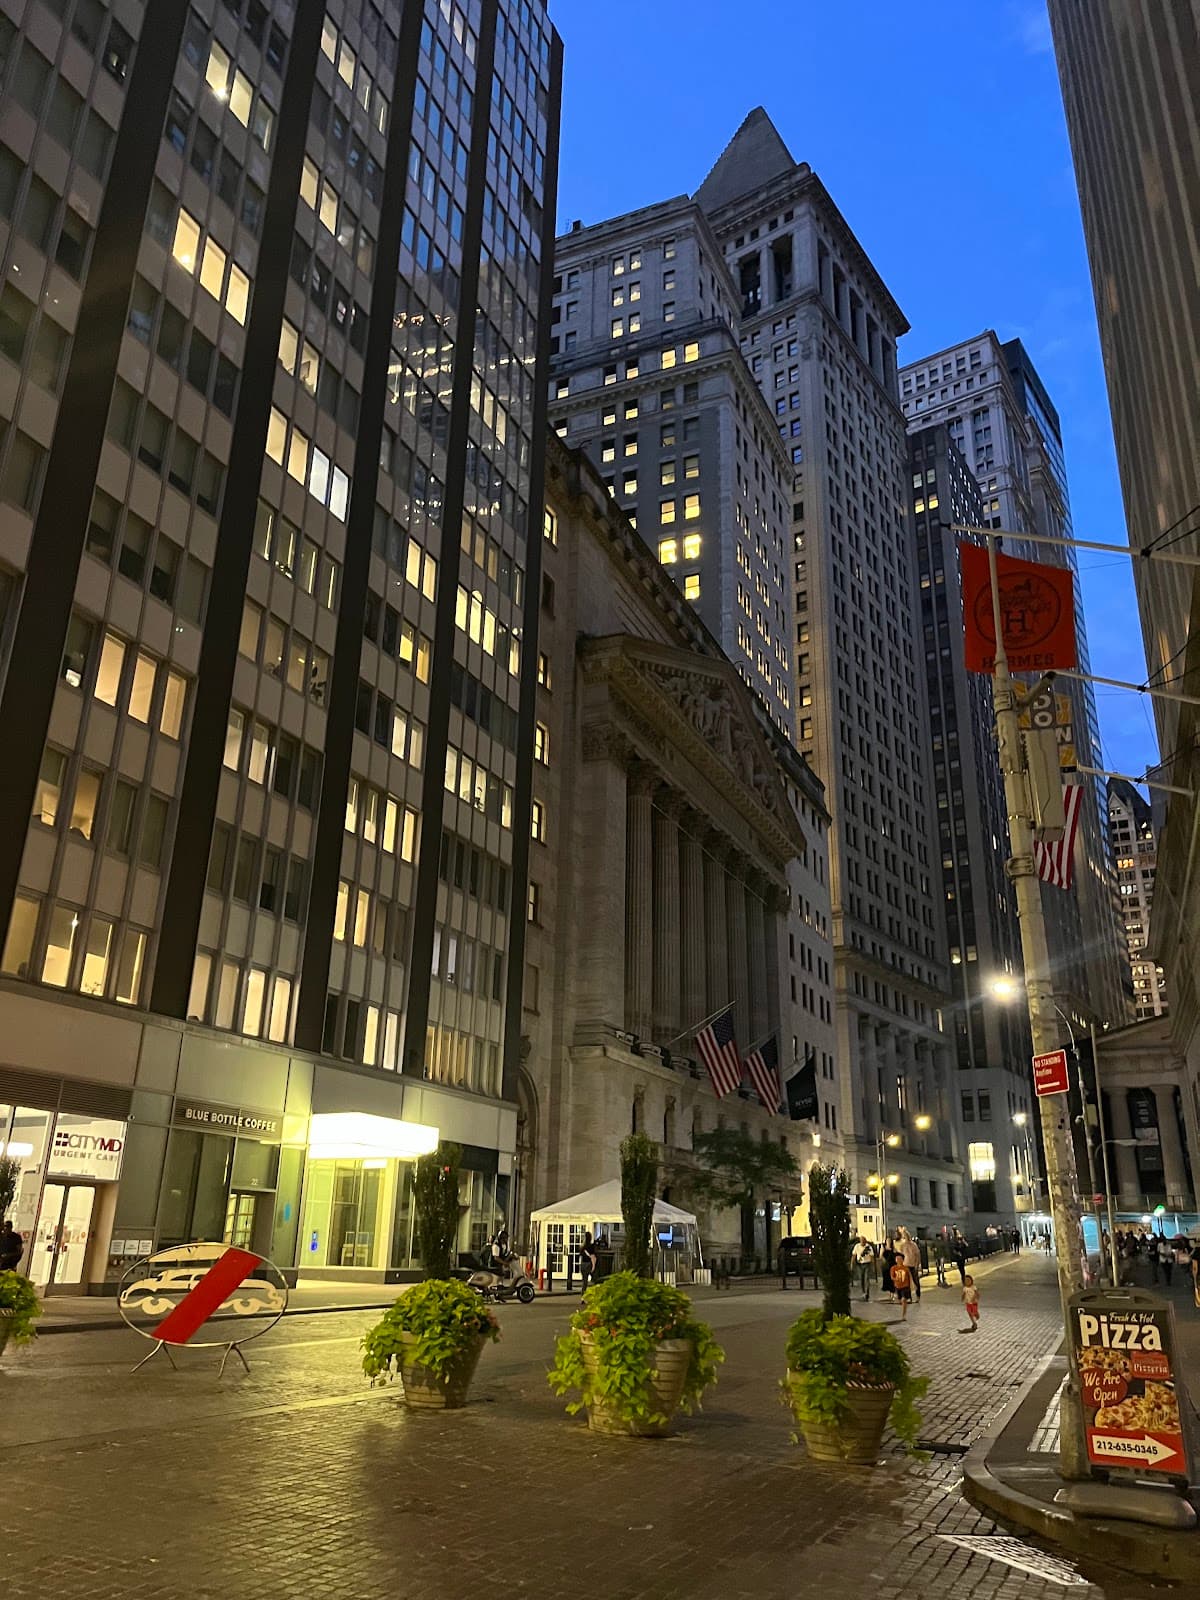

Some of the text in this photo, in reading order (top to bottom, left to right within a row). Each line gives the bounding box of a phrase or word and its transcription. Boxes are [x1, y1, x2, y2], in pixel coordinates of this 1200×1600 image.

[982, 653, 1054, 668] HRMES
[185, 1108, 276, 1132] BLUE BOTTLE COFFEE
[54, 1149, 92, 1160] URGENT
[1131, 1314, 1137, 1322] &
[1140, 1313, 1154, 1323] Hot
[1080, 1315, 1162, 1350] Pizza
[1084, 1370, 1120, 1387] We Are
[1093, 1387, 1117, 1408] Open
[1096, 1440, 1158, 1455] 212-635-0345
